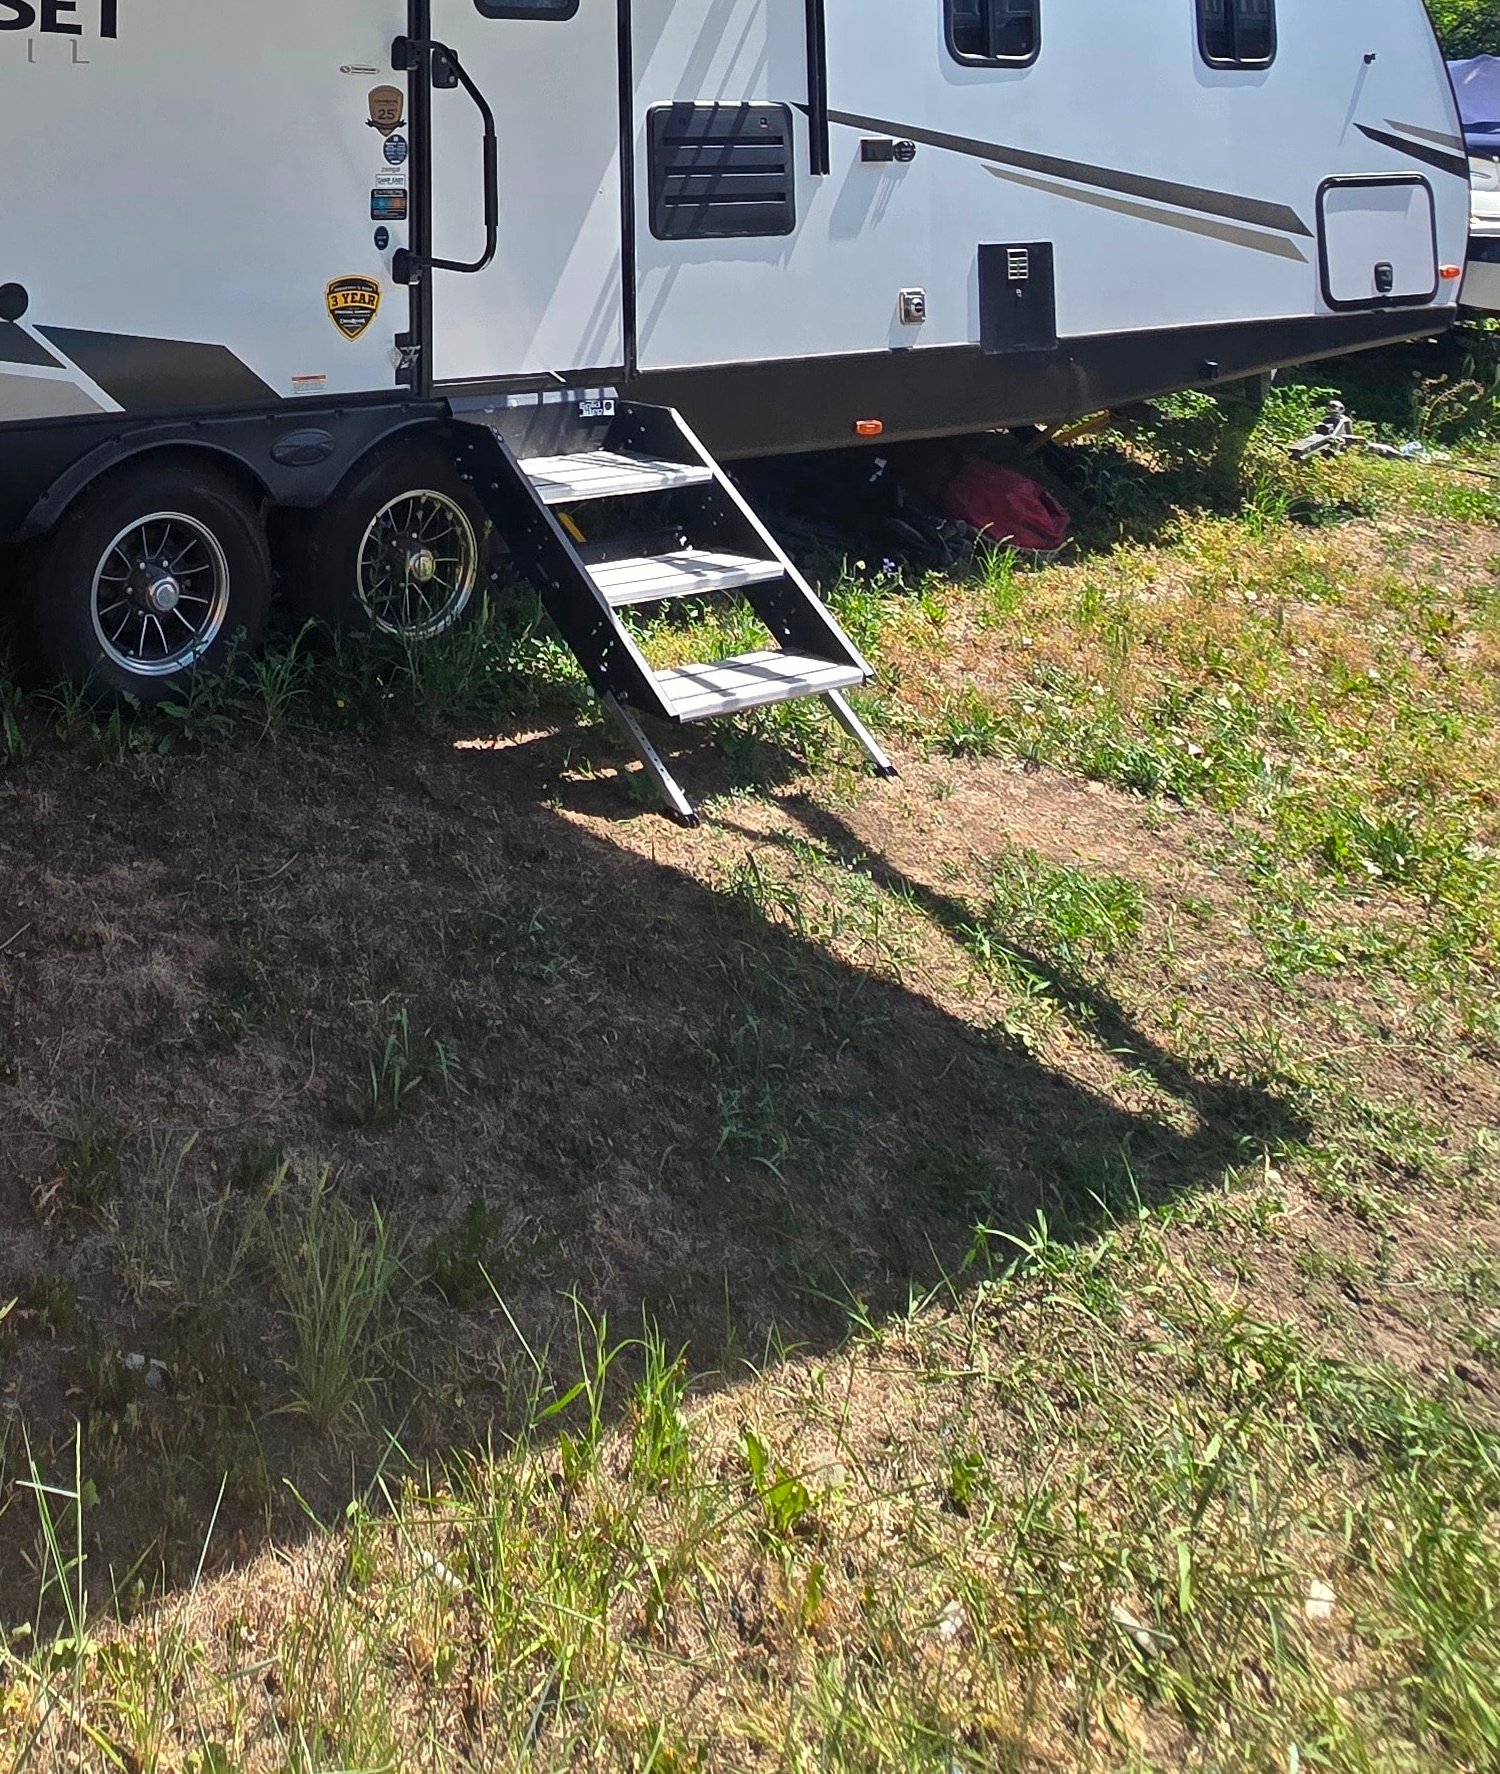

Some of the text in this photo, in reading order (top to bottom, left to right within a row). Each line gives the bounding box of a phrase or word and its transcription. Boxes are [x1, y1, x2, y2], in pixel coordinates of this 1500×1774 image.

[377, 108, 396, 121] 25
[330, 292, 376, 307] 3 YEAR
